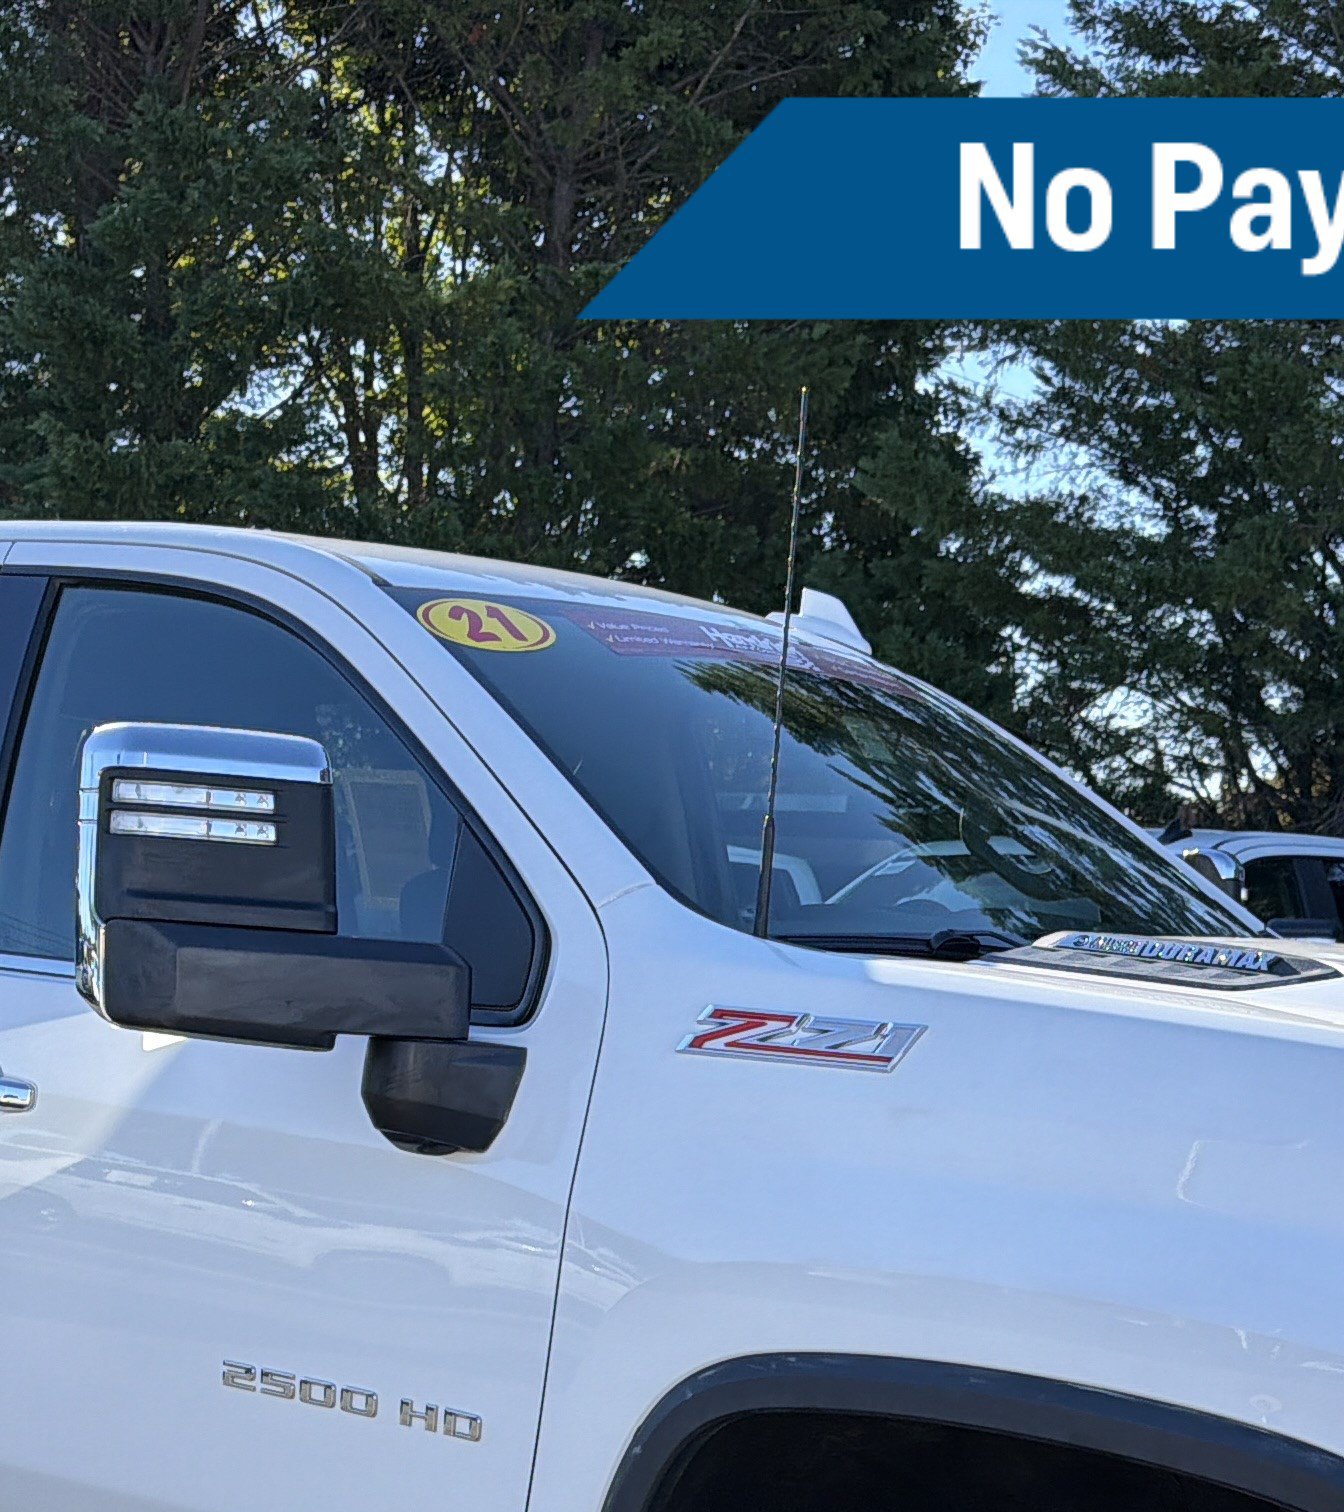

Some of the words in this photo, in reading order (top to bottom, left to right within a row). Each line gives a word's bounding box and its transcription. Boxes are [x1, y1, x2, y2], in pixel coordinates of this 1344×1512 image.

[447, 605, 529, 643] 21
[675, 1003, 929, 1074] Z71
[222, 1359, 379, 1419] 2500
[399, 1397, 483, 1443] HD
